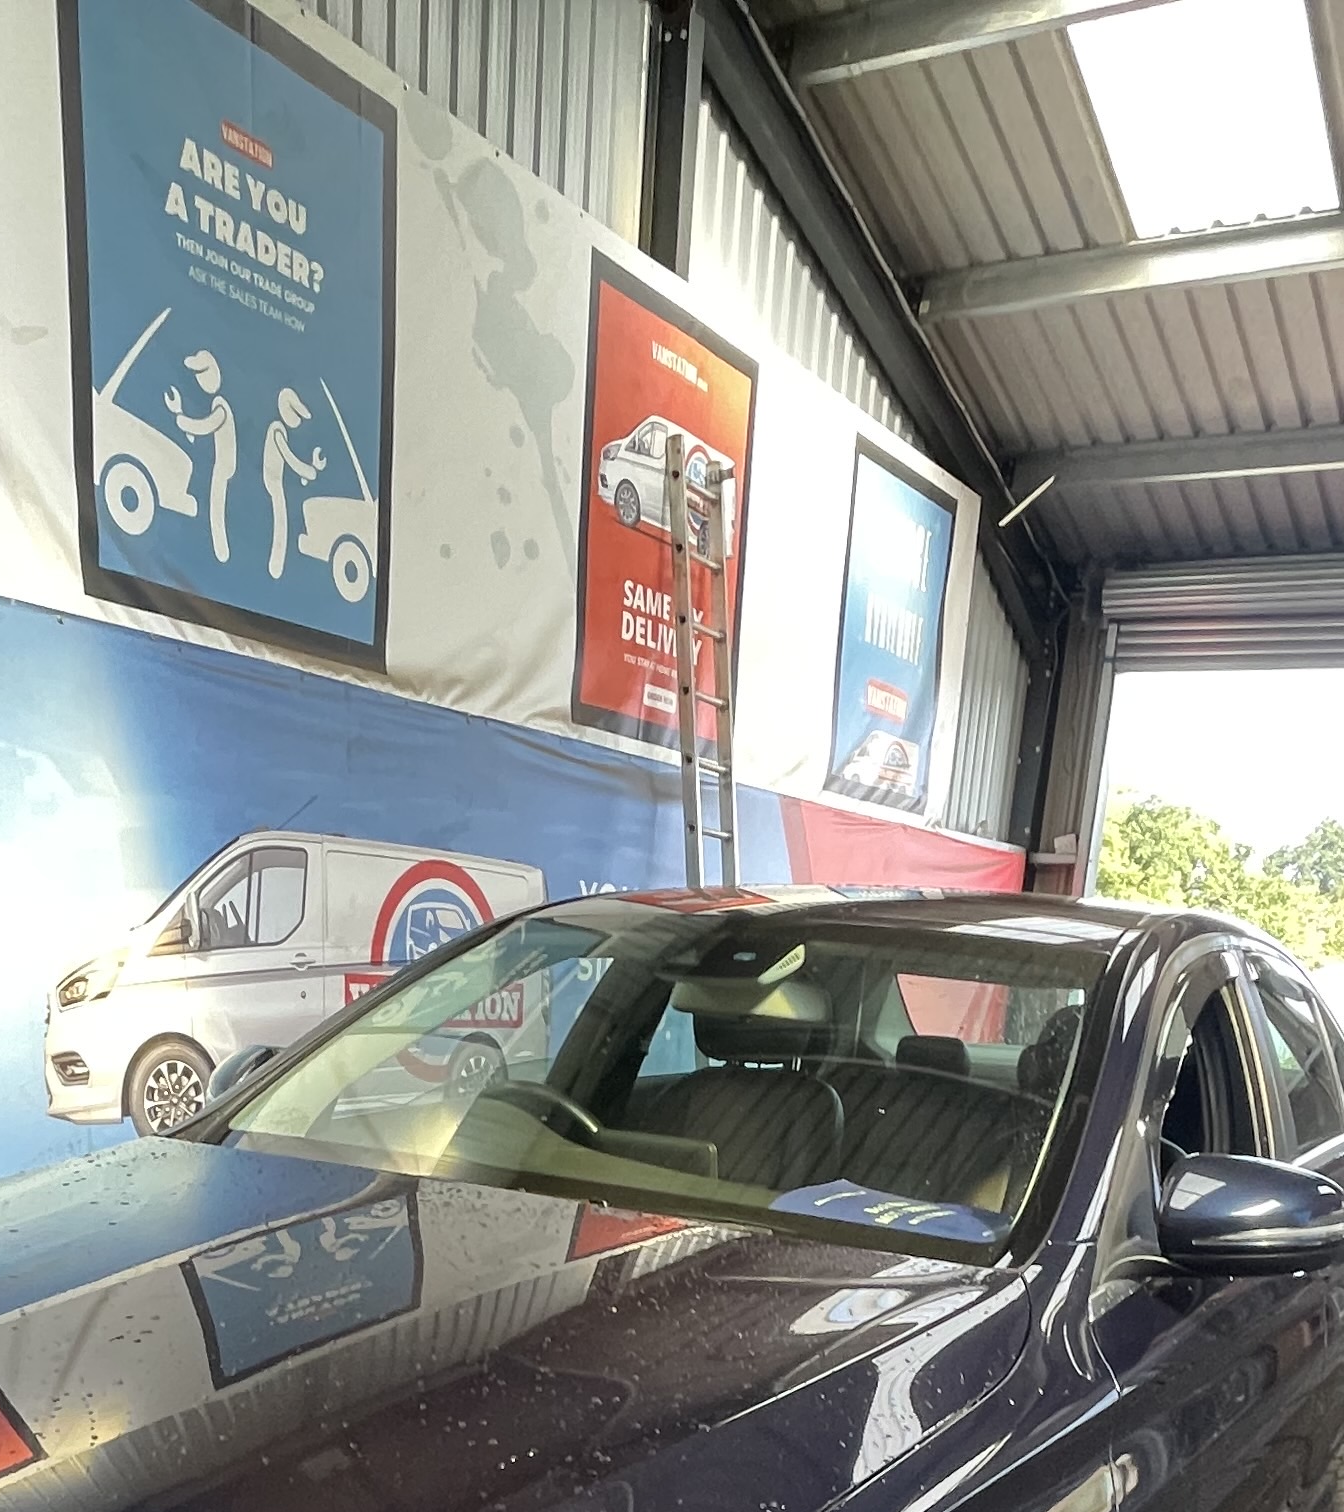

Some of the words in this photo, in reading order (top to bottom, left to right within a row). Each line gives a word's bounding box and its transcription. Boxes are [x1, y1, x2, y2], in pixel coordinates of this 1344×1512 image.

[179, 137, 241, 200] ARE
[245, 173, 307, 235] YOU
[164, 181, 189, 223] A
[194, 195, 324, 293] TRADER?
[175, 232, 203, 257] THEN
[205, 248, 229, 272] JOIN
[229, 260, 252, 283] OUR
[252, 272, 282, 300] TRADE
[284, 289, 316, 315] GROUP
[188, 265, 207, 286] ASK
[209, 275, 227, 296] THE
[229, 284, 258, 310] SALES
[258, 299, 283, 322] TEAM
[623, 579, 672, 621] SAME
[621, 610, 703, 666] DELIVY
